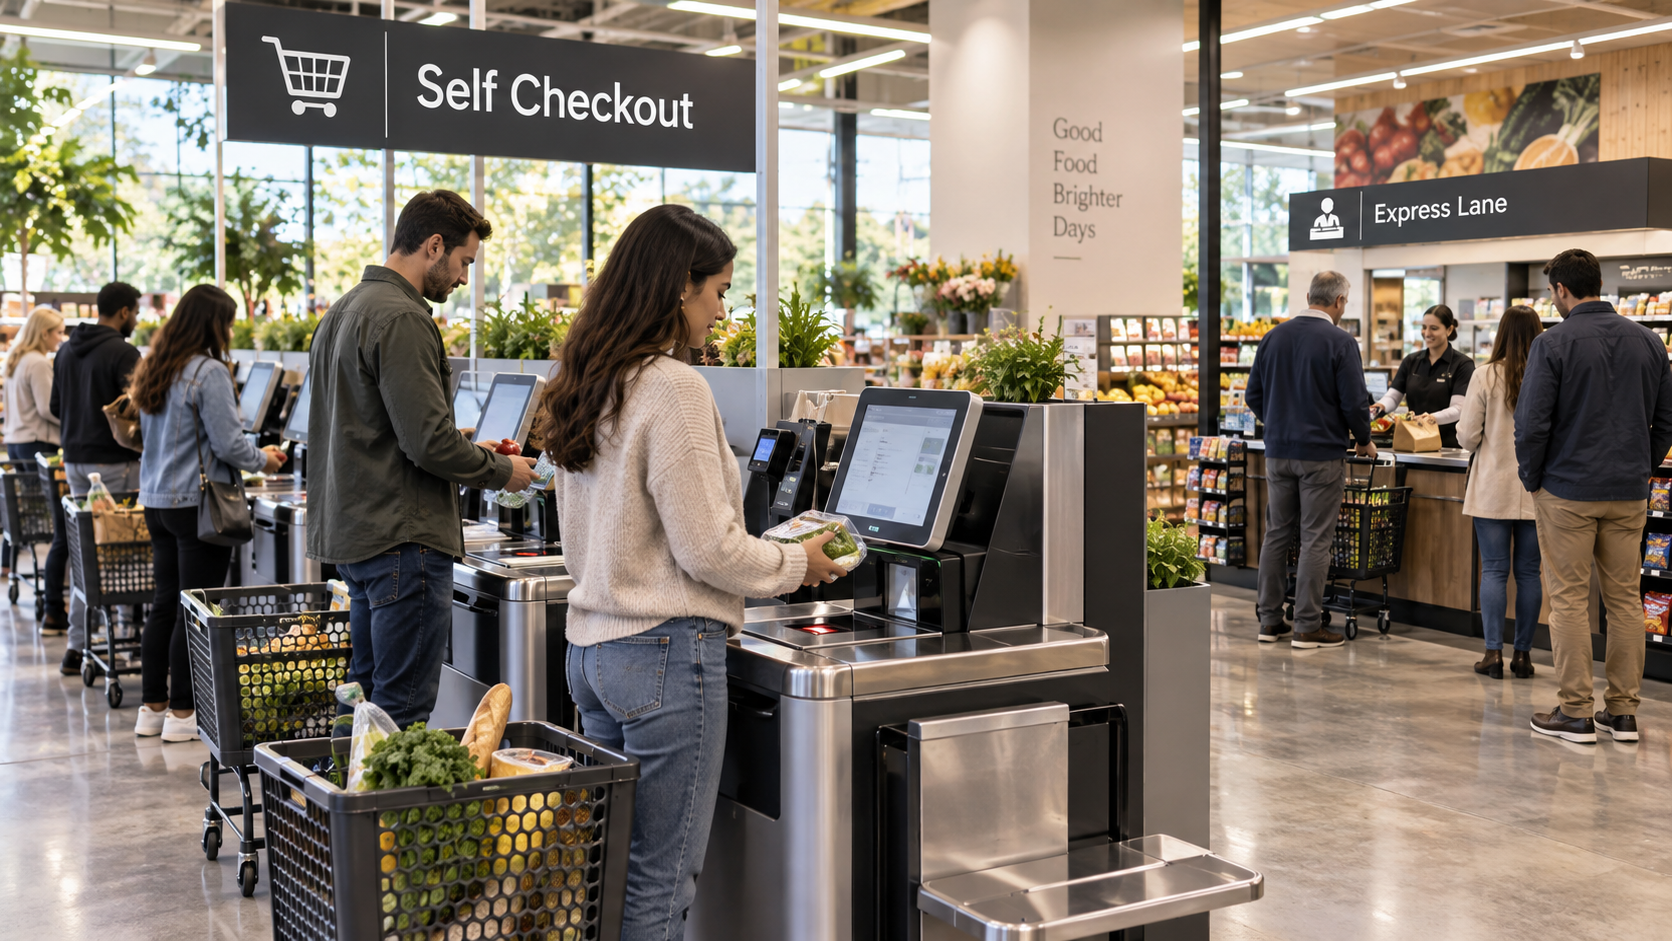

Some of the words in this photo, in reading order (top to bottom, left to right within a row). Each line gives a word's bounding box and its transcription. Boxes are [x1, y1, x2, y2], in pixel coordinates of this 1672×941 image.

[416, 63, 498, 113] Self
[510, 73, 694, 130] Checkout
[1053, 117, 1103, 143] Good
[1053, 149, 1098, 175] Food
[1053, 182, 1123, 212] Brighter
[1374, 202, 1451, 228] Express
[1457, 195, 1508, 217] Lane
[1053, 215, 1096, 244] Days
